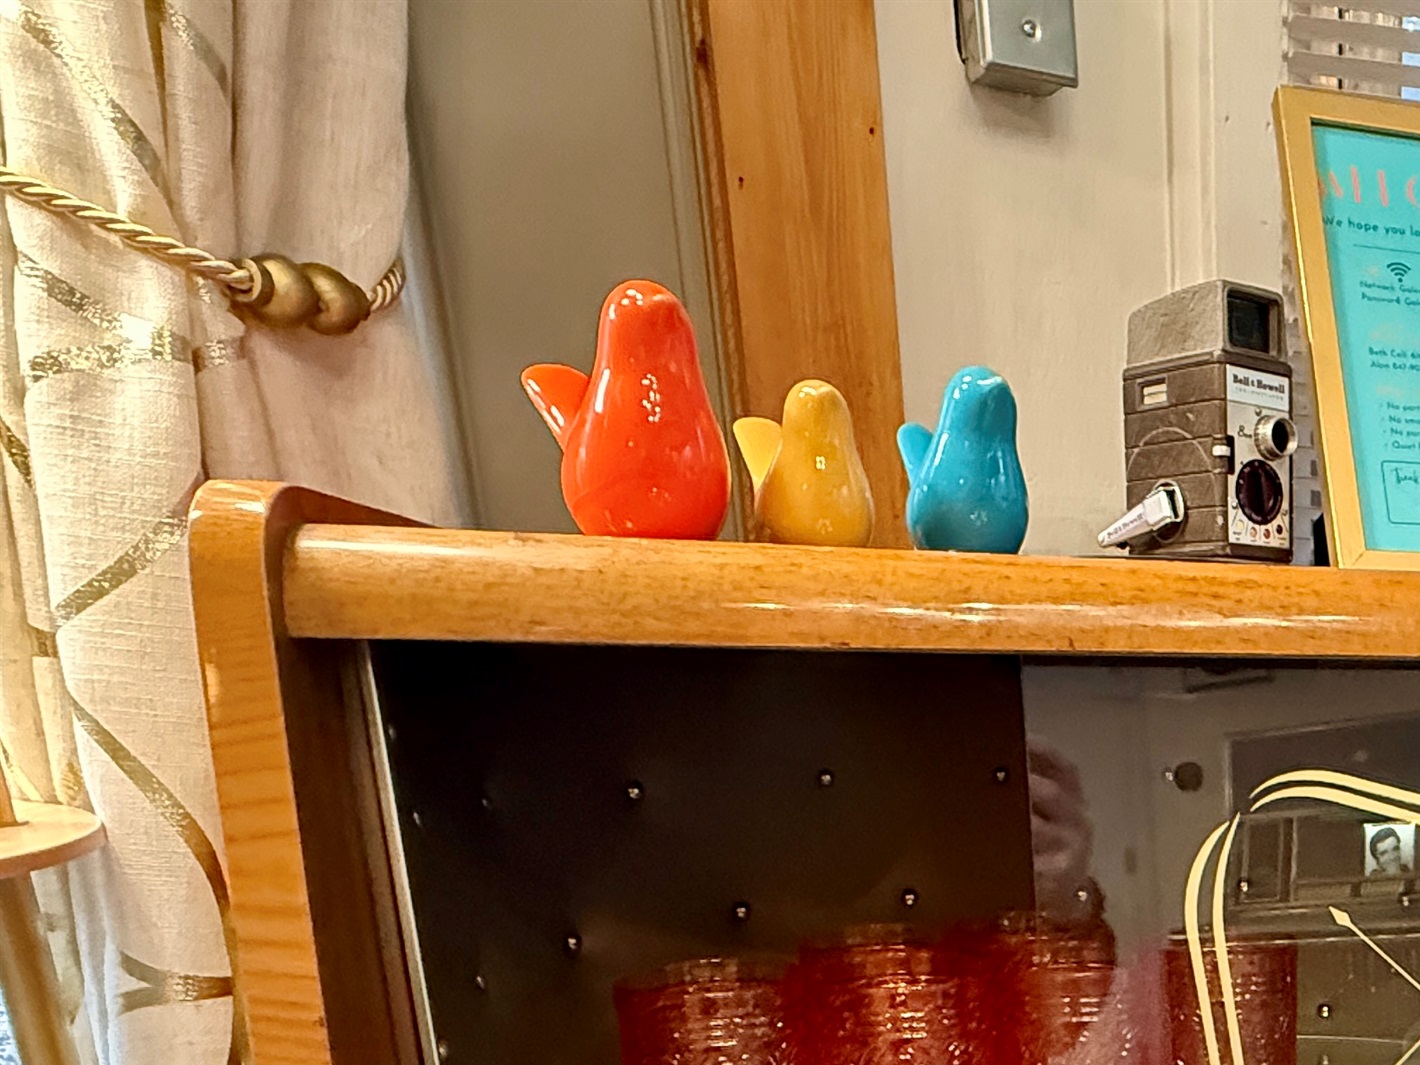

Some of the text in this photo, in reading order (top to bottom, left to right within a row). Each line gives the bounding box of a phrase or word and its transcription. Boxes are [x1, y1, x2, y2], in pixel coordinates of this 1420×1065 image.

[1323, 215, 1343, 228] We
[1347, 217, 1379, 233] hope
[1383, 226, 1406, 236] you
[1232, 373, 1250, 387] Bell
[1256, 379, 1285, 394] Howell
